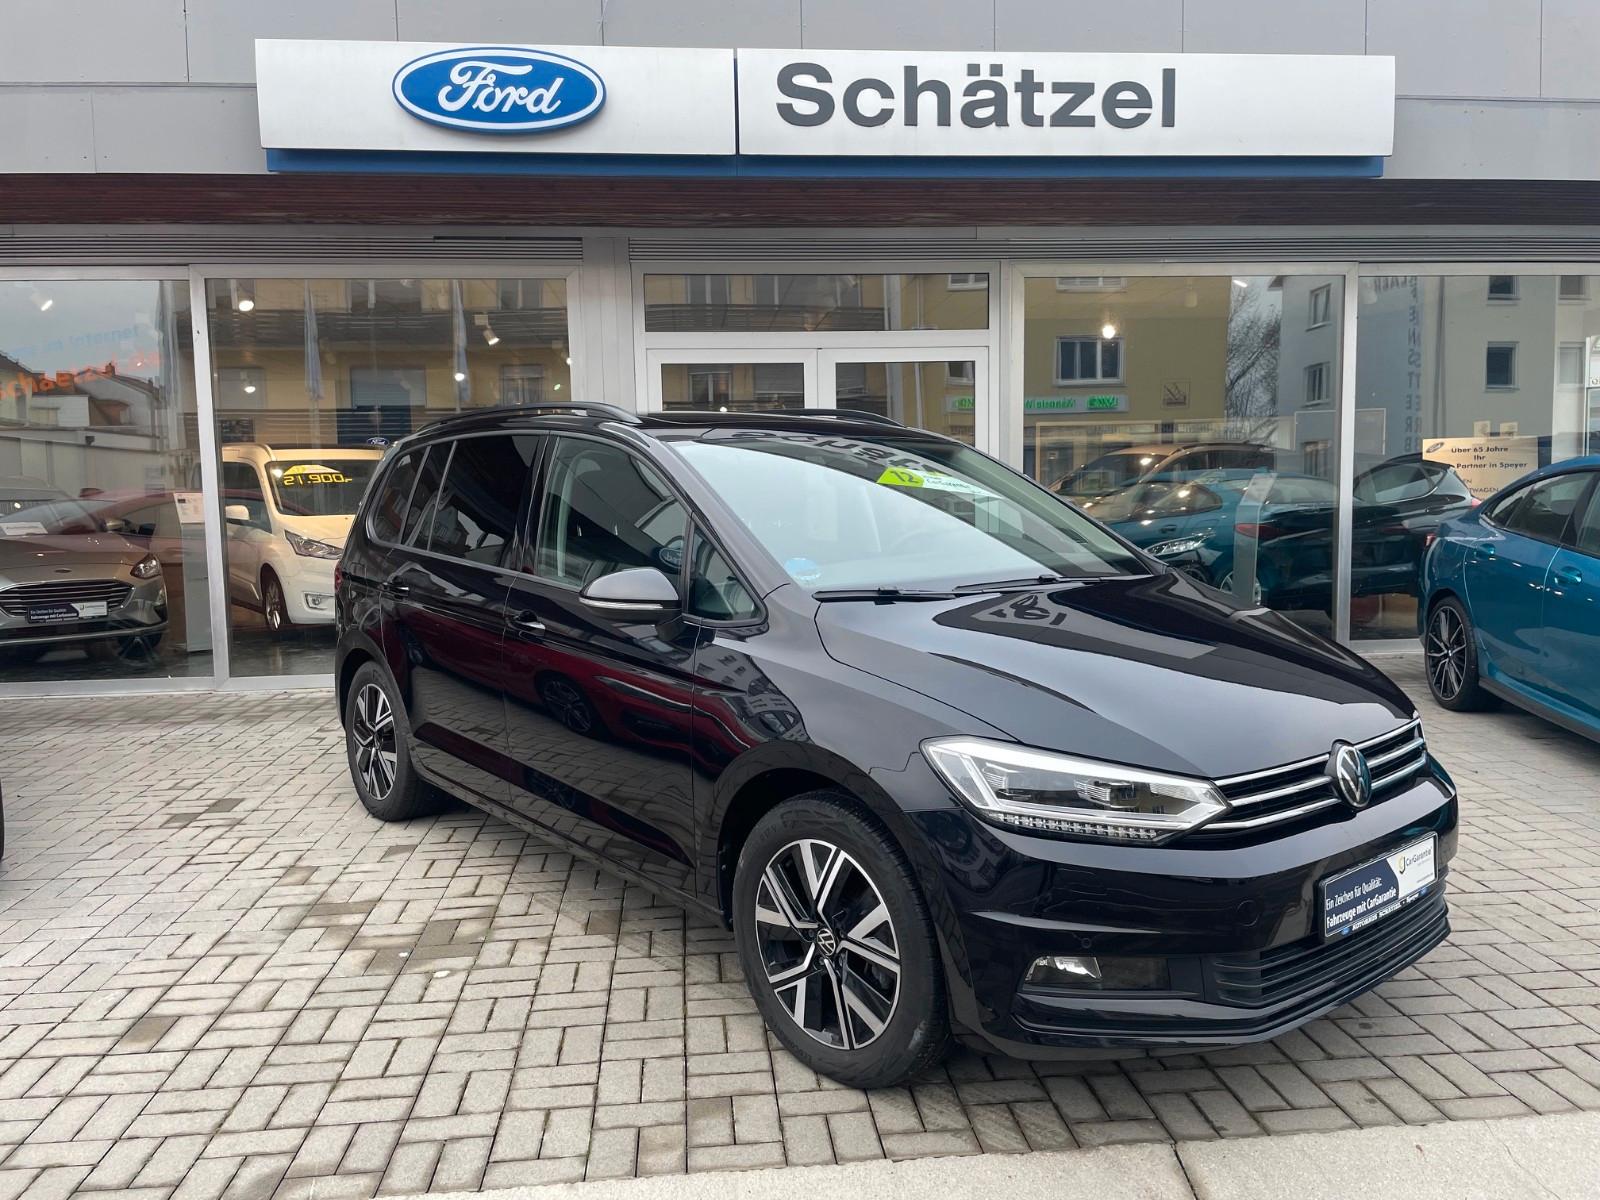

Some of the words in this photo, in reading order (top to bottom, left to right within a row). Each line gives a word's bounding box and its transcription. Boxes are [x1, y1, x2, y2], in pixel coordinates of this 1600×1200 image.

[438, 60, 564, 114] Ford
[775, 62, 1176, 128] Schätzel
[1486, 445, 1509, 453] Jahre
[1325, 897, 1334, 911] Ein
[1335, 889, 1354, 907] Zeichen
[1354, 885, 1362, 897] für
[1326, 907, 1356, 928] Fahrzeuge
[1356, 903, 1367, 915] mit
[1367, 886, 1397, 909] CarGarantie
